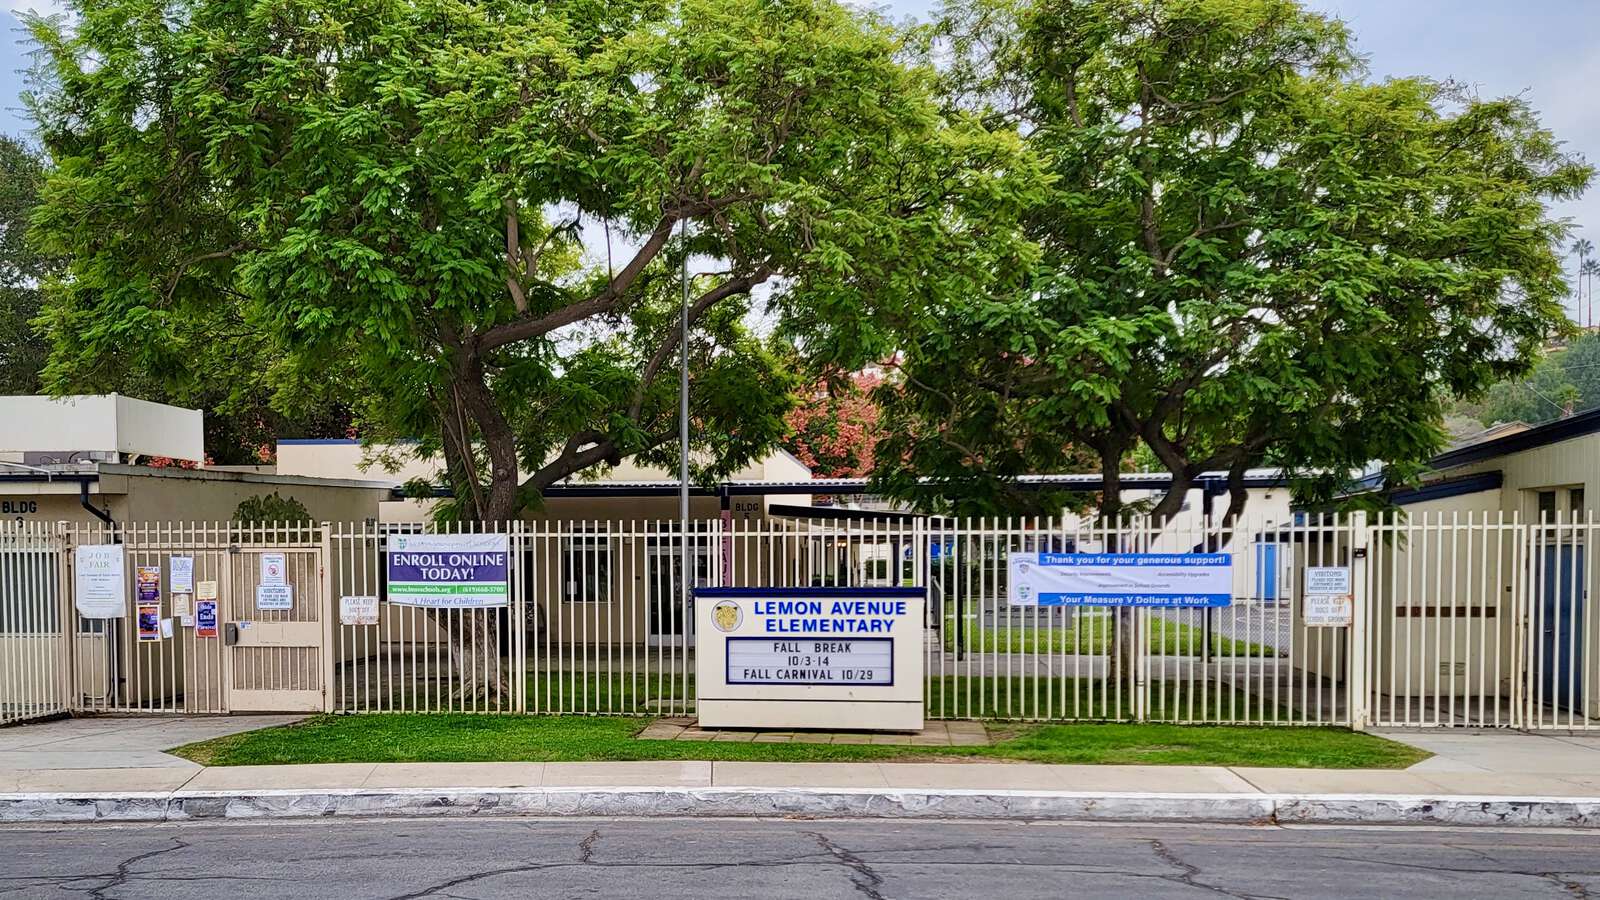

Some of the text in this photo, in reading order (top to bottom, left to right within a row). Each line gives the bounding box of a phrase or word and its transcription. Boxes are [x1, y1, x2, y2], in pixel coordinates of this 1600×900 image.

[2, 501, 37, 513] BLDG
[735, 503, 759, 511] BLDG
[89, 560, 110, 568] FAIR
[393, 554, 504, 566] ENROLL ONLINE
[1045, 555, 1073, 564] Thank
[1076, 557, 1094, 565] you
[1097, 556, 1111, 564] for
[1113, 557, 1134, 565] your
[1137, 557, 1181, 565] generous
[1184, 556, 1225, 565] support!
[420, 568, 474, 580] TODAY!
[441, 597, 453, 605] for
[453, 597, 484, 605] Children
[1059, 595, 1209, 604] Your Measure V Dollars at Work
[754, 601, 907, 615] LEMON AVENUE
[765, 619, 895, 633] ELEMENTARY
[773, 642, 852, 653] FALL BREAK
[788, 656, 829, 666] 10/3-14
[743, 669, 873, 680] FALL CARNIVAL 10/29
